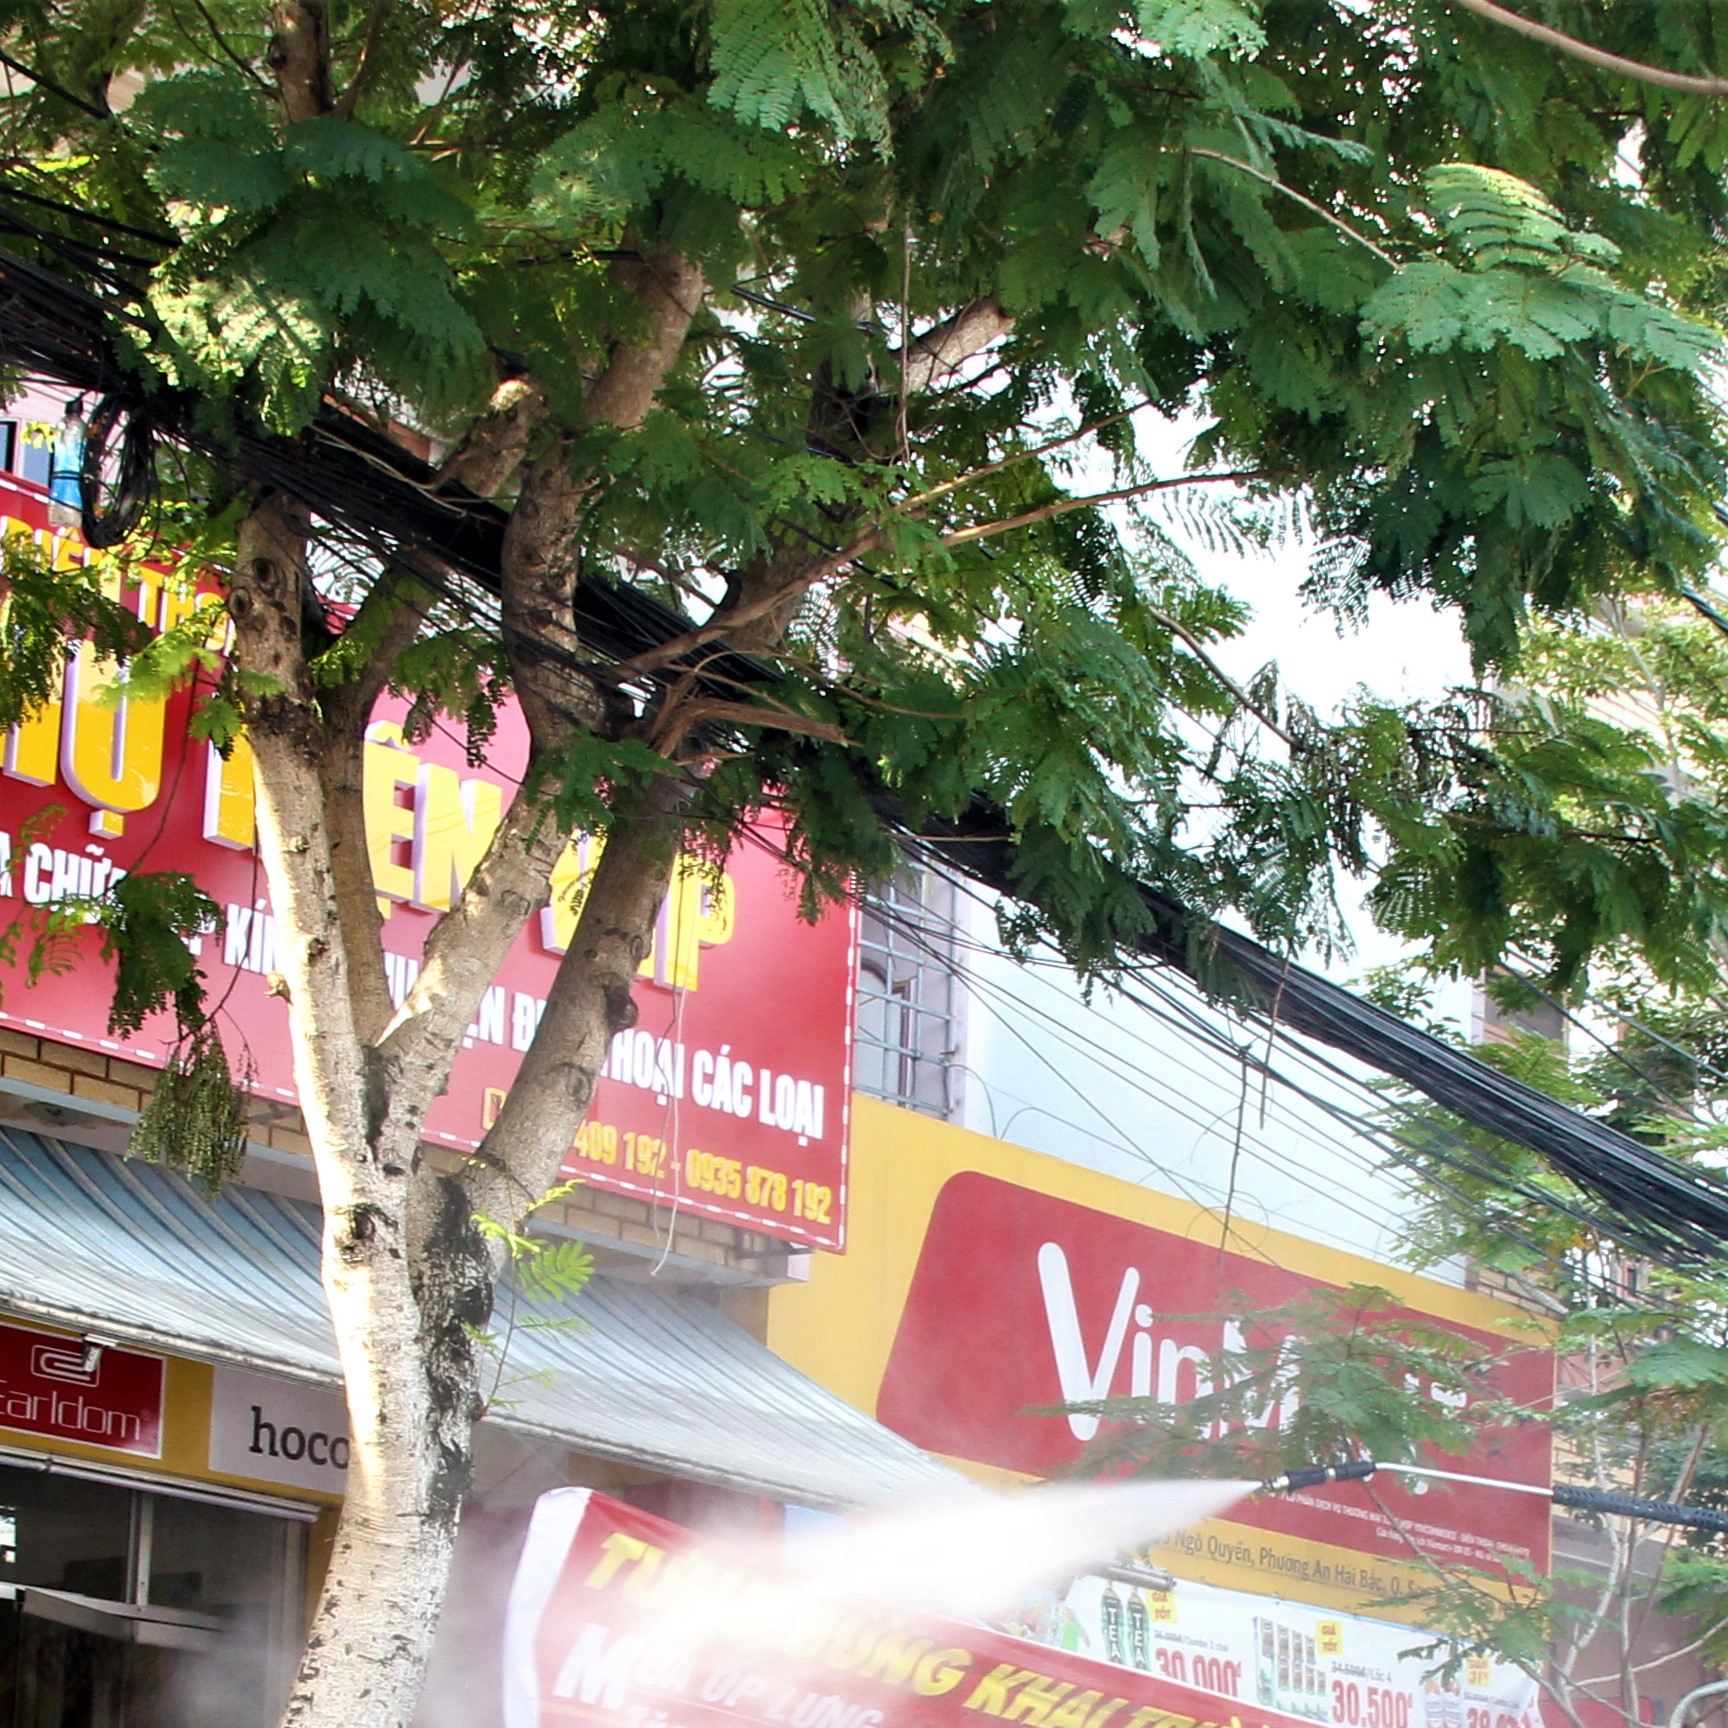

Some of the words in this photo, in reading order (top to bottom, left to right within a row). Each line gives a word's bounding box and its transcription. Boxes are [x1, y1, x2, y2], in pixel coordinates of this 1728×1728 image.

[600, 1029, 685, 1106] HOẠI
[692, 1044, 754, 1118] CÁC
[758, 1068, 825, 1147] LOẠI
[623, 1131, 667, 1179] 192
[685, 1149, 743, 1199] 0935
[745, 1165, 788, 1212] 878
[792, 1179, 832, 1225] 192
[1315, 1559, 1330, 1580] An
